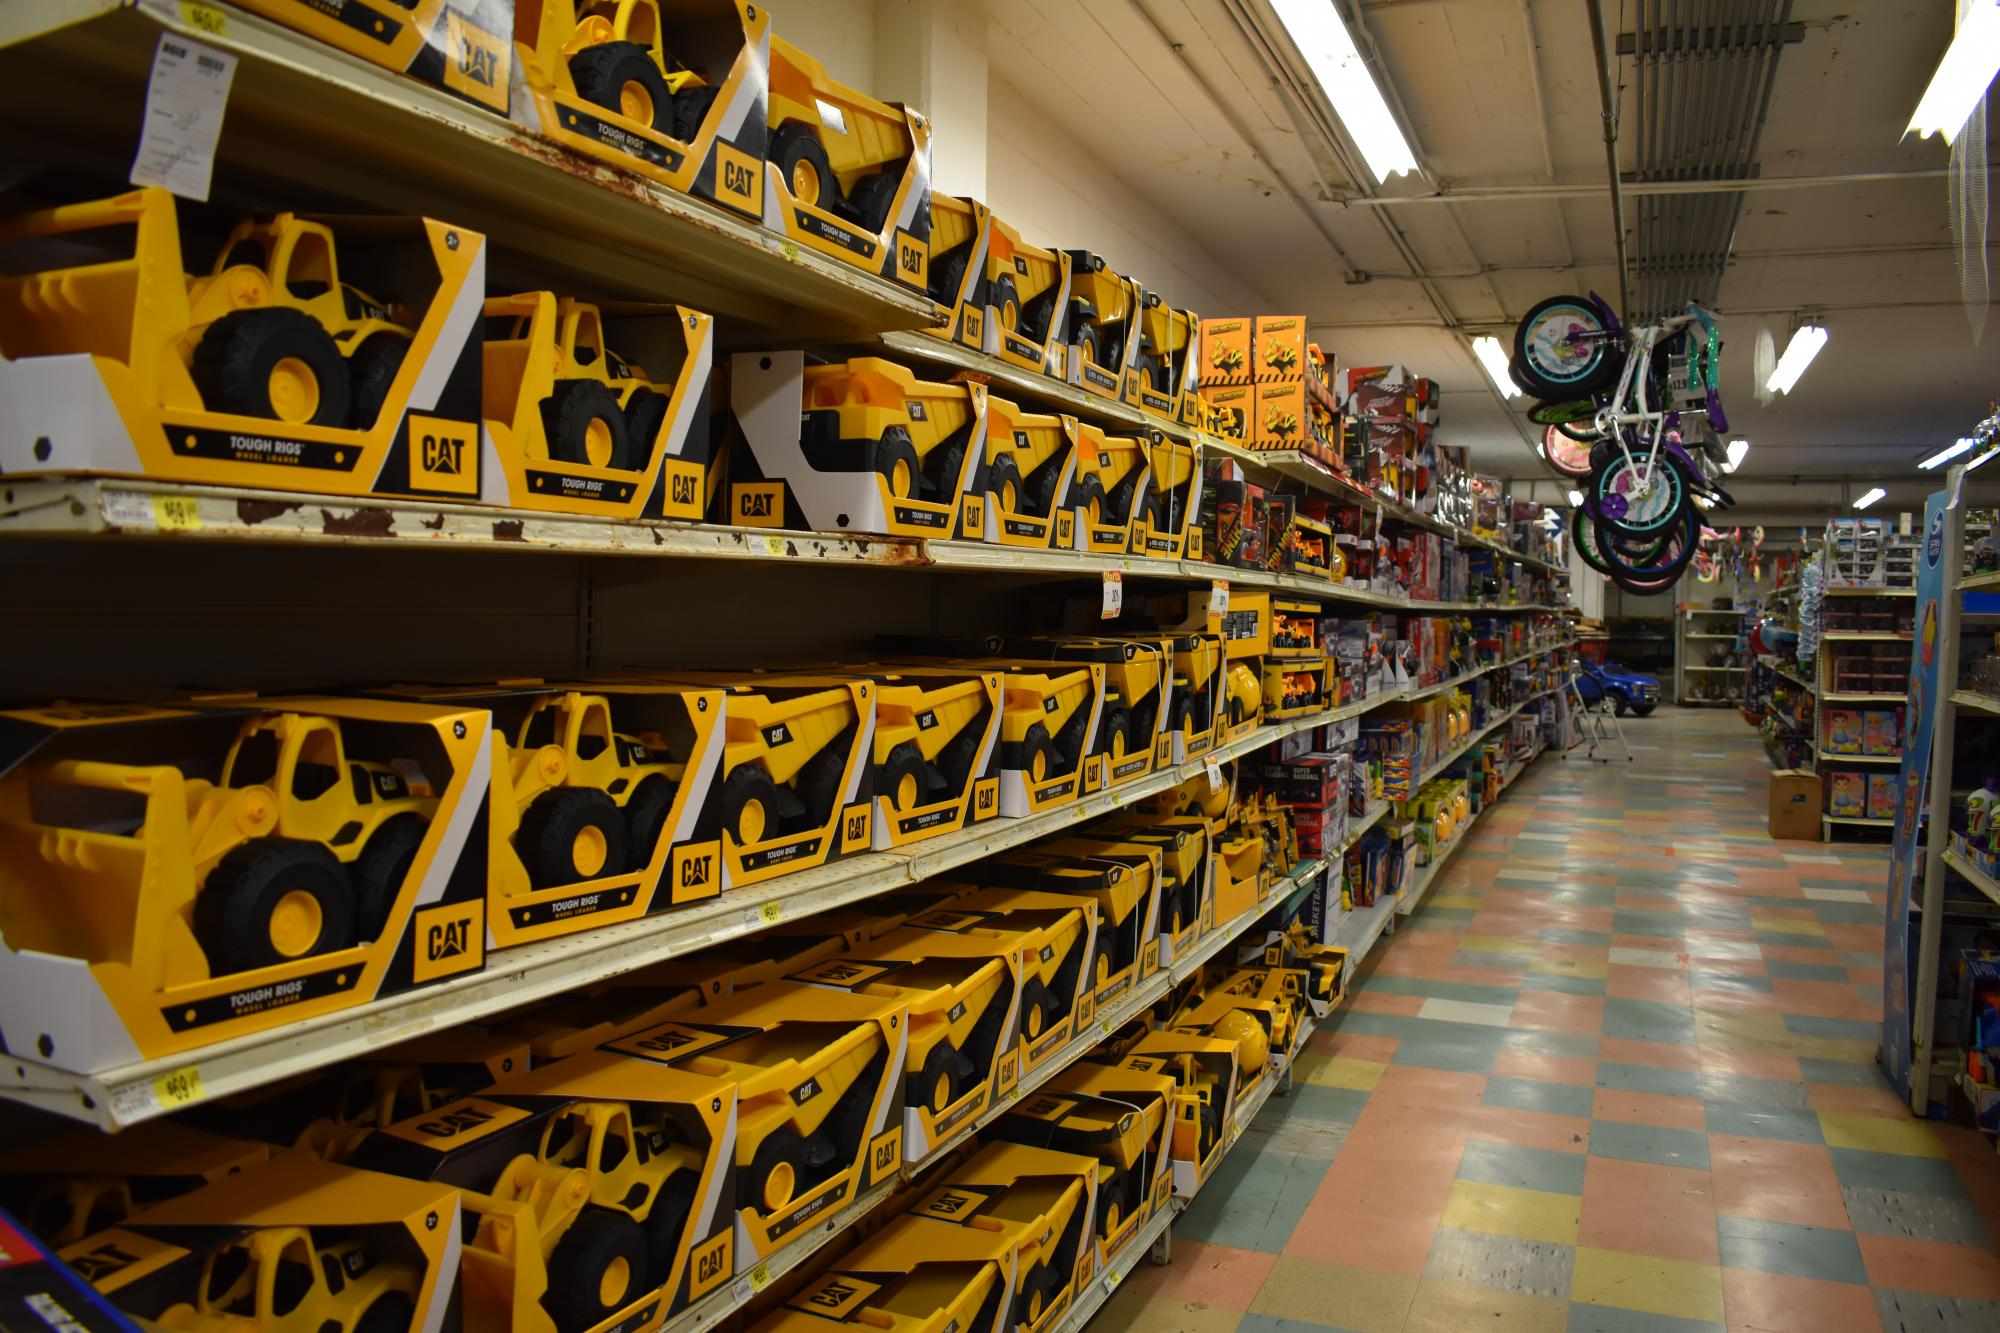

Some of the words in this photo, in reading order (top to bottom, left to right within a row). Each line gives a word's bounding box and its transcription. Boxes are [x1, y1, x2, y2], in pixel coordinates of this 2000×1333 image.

[598, 123, 625, 142] TOUGH
[626, 135, 645, 148] RIGS
[725, 160, 754, 198] CAT
[821, 222, 837, 237] TOUGH
[837, 230, 851, 242] RIGS
[902, 245, 922, 275] CAT
[967, 314, 979, 337] CAT
[230, 435, 272, 452] TOUGH
[274, 440, 301, 455] RIGS
[422, 434, 464, 474] CAT
[235, 450, 263, 461] WHEEL
[266, 453, 300, 465] LOADER
[561, 477, 585, 489] TOUGH
[586, 480, 603, 491] RIGS
[673, 474, 696, 505] CAT
[740, 493, 774, 517] CAT
[967, 505, 980, 527] CAT
[1060, 519, 1071, 537] CAT
[1134, 529, 1144, 546] CAT
[1191, 535, 1200, 551] CAT
[922, 714, 932, 726] CAT
[771, 727, 784, 742] CAT
[632, 746, 646, 758] CAT
[380, 776, 398, 790] CAT
[1088, 766, 1098, 782] CAT
[979, 787, 994, 809] CAT
[848, 814, 867, 841] CAT
[766, 849, 782, 858] TOUGH
[782, 846, 797, 856] RIGS
[682, 855, 711, 887] CAT
[552, 898, 579, 912] TOUGH
[581, 894, 600, 907] RIGS
[428, 918, 471, 960] CAT
[230, 986, 273, 1007] TOUGH
[275, 980, 303, 997] RIGS
[236, 1004, 264, 1016] WHEEL
[267, 994, 301, 1008] LOADER
[1081, 1000, 1090, 1020] CAT
[637, 1031, 698, 1052] CAT
[1001, 1062, 1014, 1083] CAT
[800, 1083, 812, 1100] CAT
[417, 1108, 495, 1138] CAT
[652, 1132, 664, 1146] CAT
[877, 1139, 895, 1171] CAT
[793, 1207, 808, 1221] TOUGH
[809, 1197, 823, 1211] RIGS
[930, 1193, 969, 1215] CAT
[70, 1243, 141, 1281] AT
[699, 1245, 725, 1283] CAT
[1081, 1262, 1090, 1281] CAT
[810, 1281, 859, 1307] CAT
